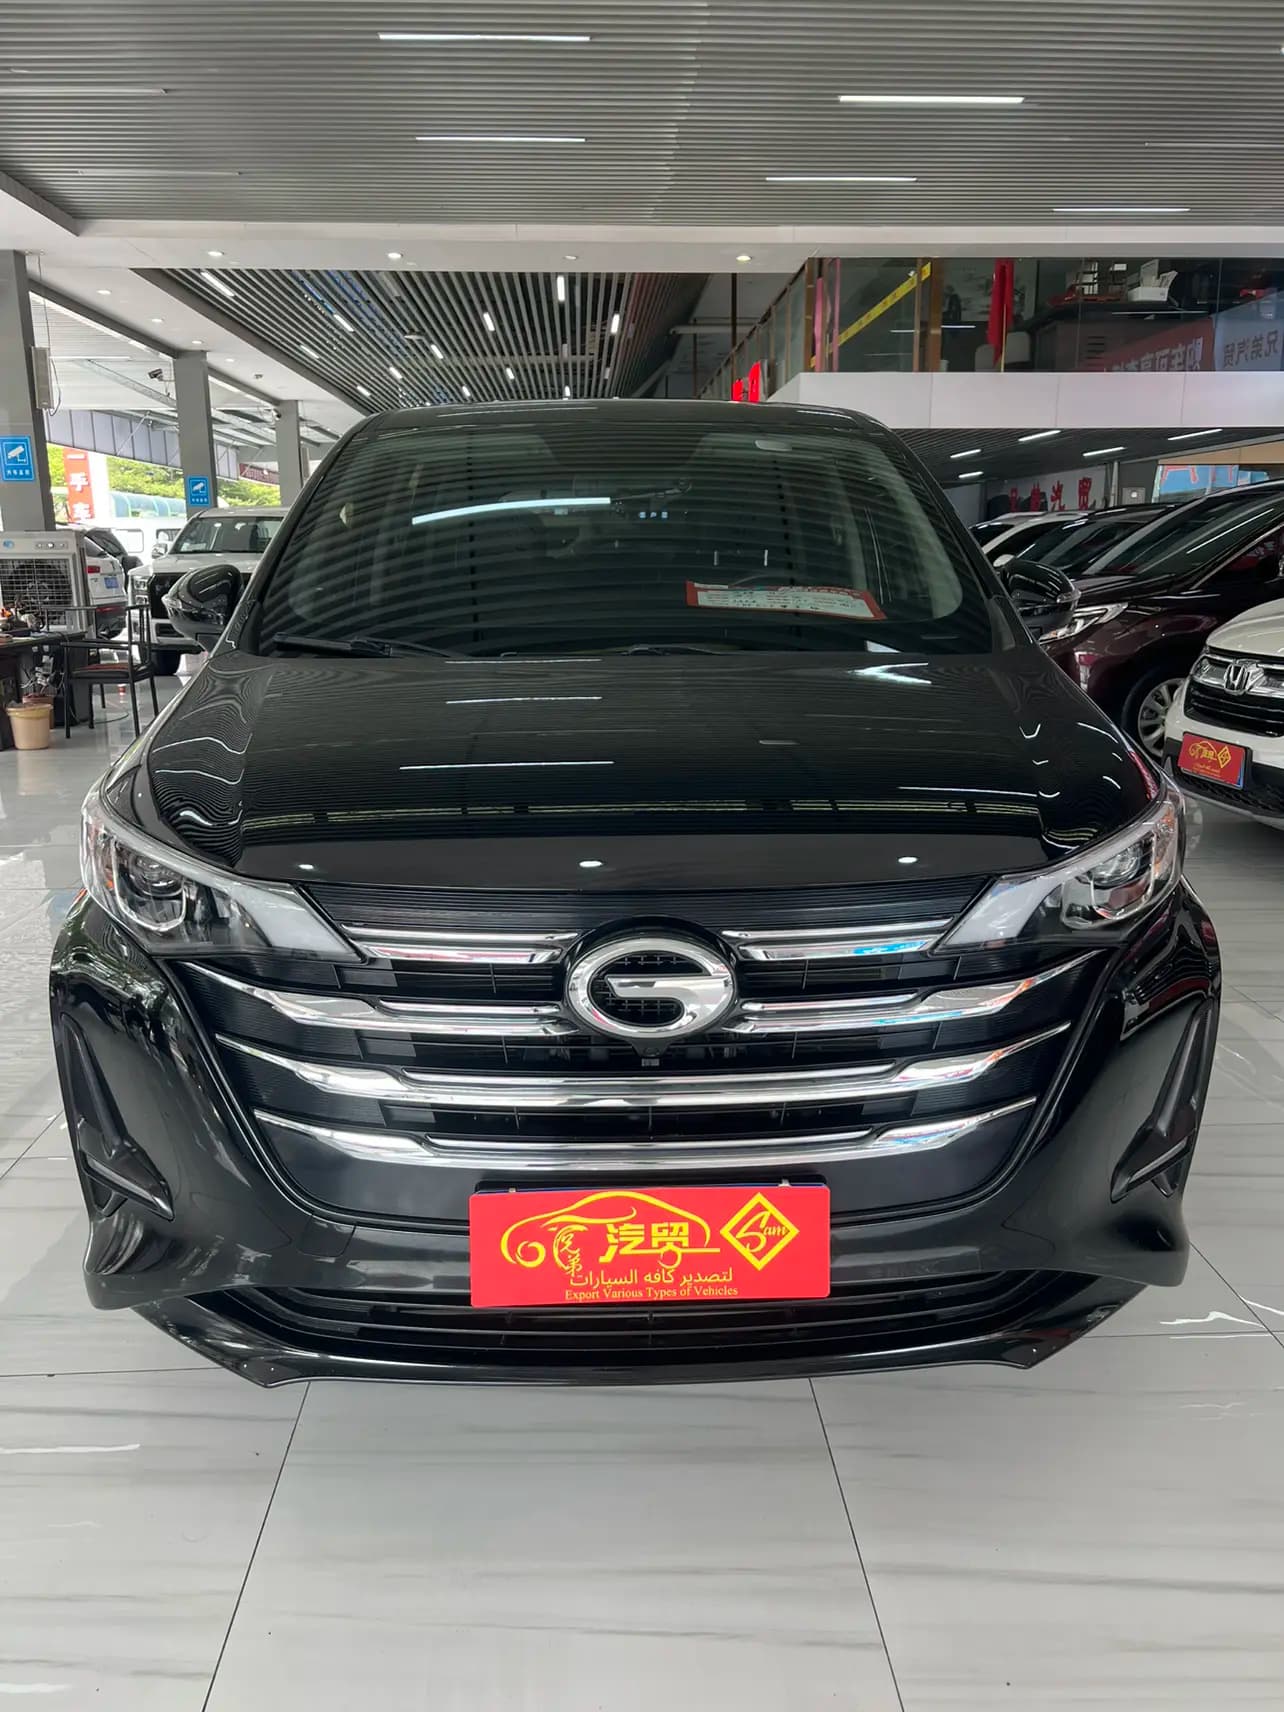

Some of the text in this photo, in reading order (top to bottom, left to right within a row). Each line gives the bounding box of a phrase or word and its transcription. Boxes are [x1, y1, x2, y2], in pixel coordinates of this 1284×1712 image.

[598, 1222, 689, 1264] 汽贸
[565, 1283, 738, 1302] Export Various Types of Vehicles
